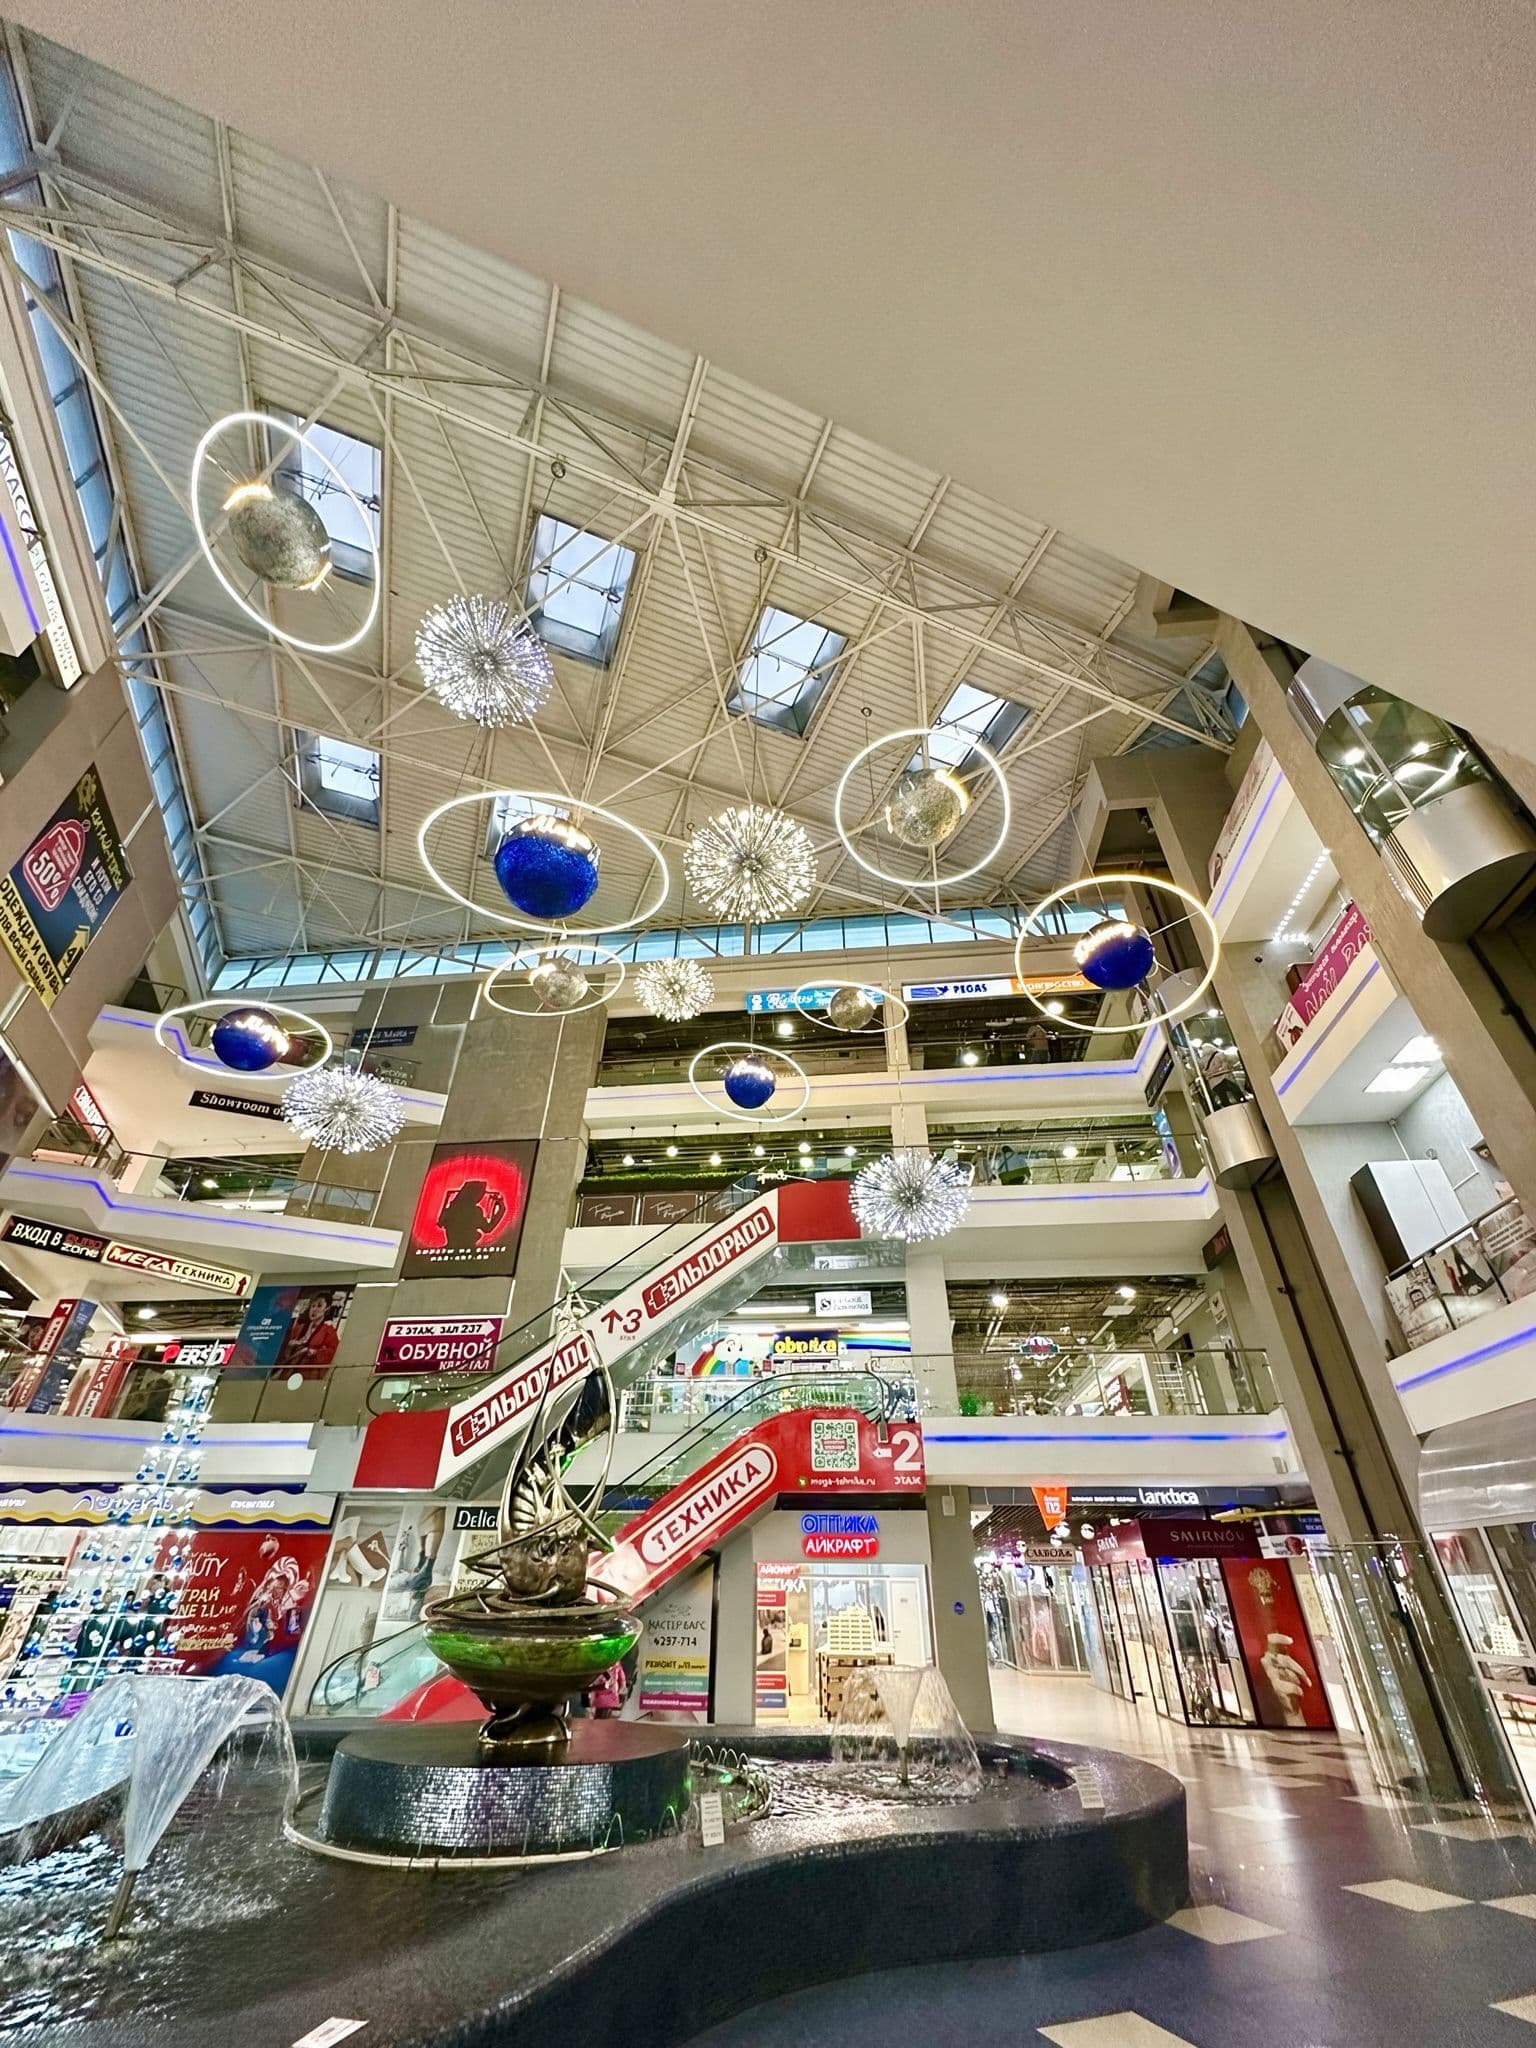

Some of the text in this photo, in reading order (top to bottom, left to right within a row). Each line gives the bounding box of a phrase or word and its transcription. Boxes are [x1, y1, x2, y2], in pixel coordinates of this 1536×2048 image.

[32, 851, 66, 900] 50%
[0, 878, 34, 944] ОДЕЖДА
[31, 939, 42, 956] И
[953, 983, 987, 995] PEGAS
[200, 1092, 270, 1115] Showroom
[12, 1222, 51, 1247] ВХОД
[51, 1231, 63, 1247] В
[109, 1247, 231, 1288] МЕГА ТЕХНИКА
[395, 1326, 404, 1335] 2
[439, 1326, 459, 1334] ЗАЛ
[460, 1324, 483, 1334] 237
[622, 1308, 643, 1334] 3
[399, 1337, 494, 1361] ОБУВНОЙ
[891, 1430, 922, 1472] 2
[893, 1476, 921, 1485] ЭТАЖ
[651, 1461, 762, 1551] ТЕХНИКА
[801, 1513, 879, 1534] ОПТИКА
[805, 1535, 877, 1554] АЙКРАФТ
